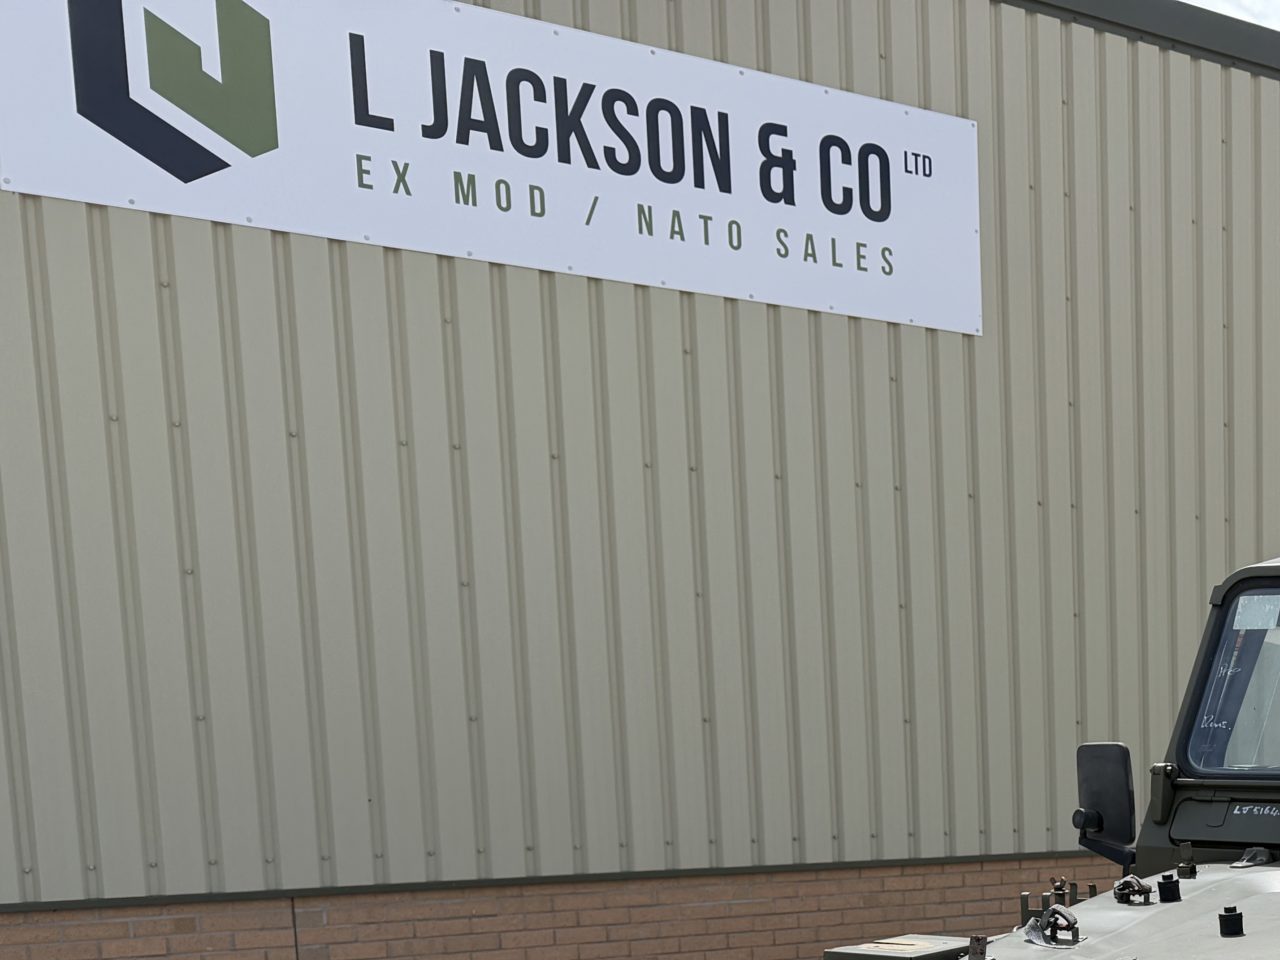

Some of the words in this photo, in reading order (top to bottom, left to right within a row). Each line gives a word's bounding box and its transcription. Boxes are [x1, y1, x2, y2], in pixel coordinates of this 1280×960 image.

[349, 32, 395, 132] L
[421, 49, 733, 194] JACKSON
[758, 122, 797, 207] &
[818, 134, 893, 223] CO
[904, 149, 933, 178] LTD
[356, 153, 413, 197] EX
[452, 170, 547, 218] MOD
[584, 195, 600, 226] /
[636, 203, 743, 252] NATO
[775, 228, 895, 277] SALES
